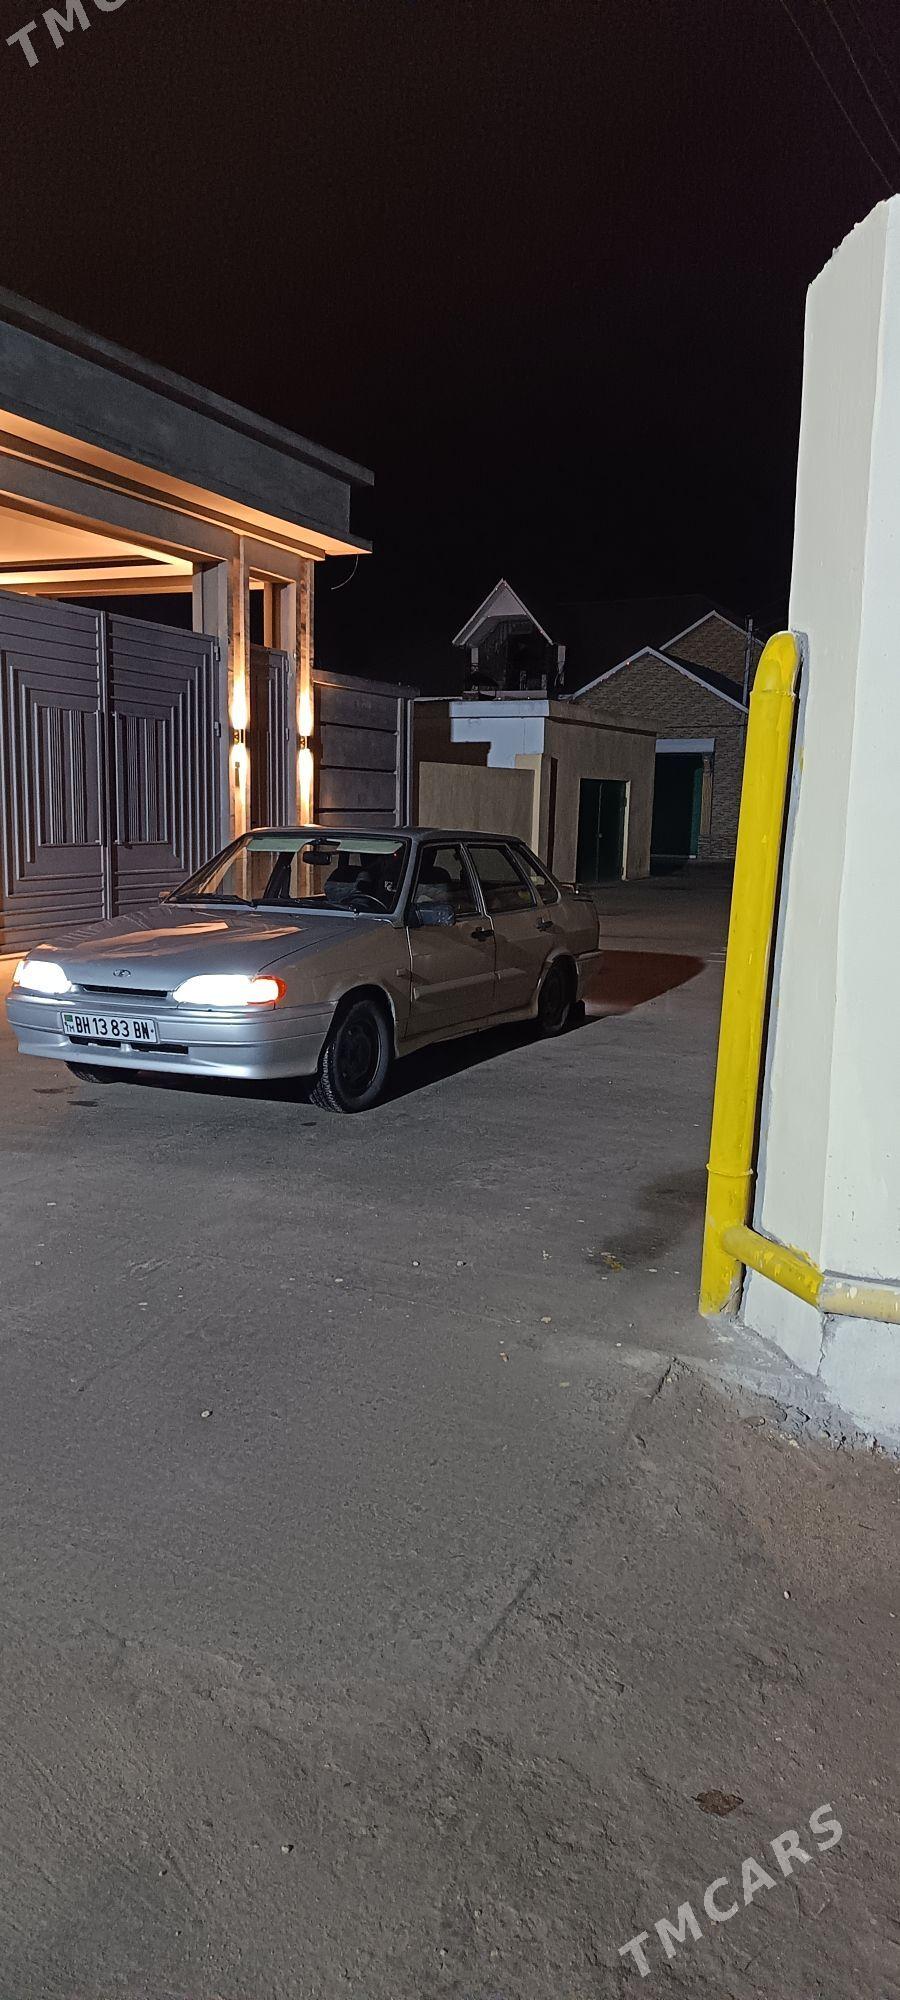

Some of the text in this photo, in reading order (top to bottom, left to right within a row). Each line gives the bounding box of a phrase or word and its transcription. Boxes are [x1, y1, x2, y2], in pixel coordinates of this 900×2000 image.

[66, 1024, 75, 1033] TM
[75, 1016, 91, 1035] BH
[92, 1017, 108, 1036] 13
[110, 1019, 130, 1038] 83
